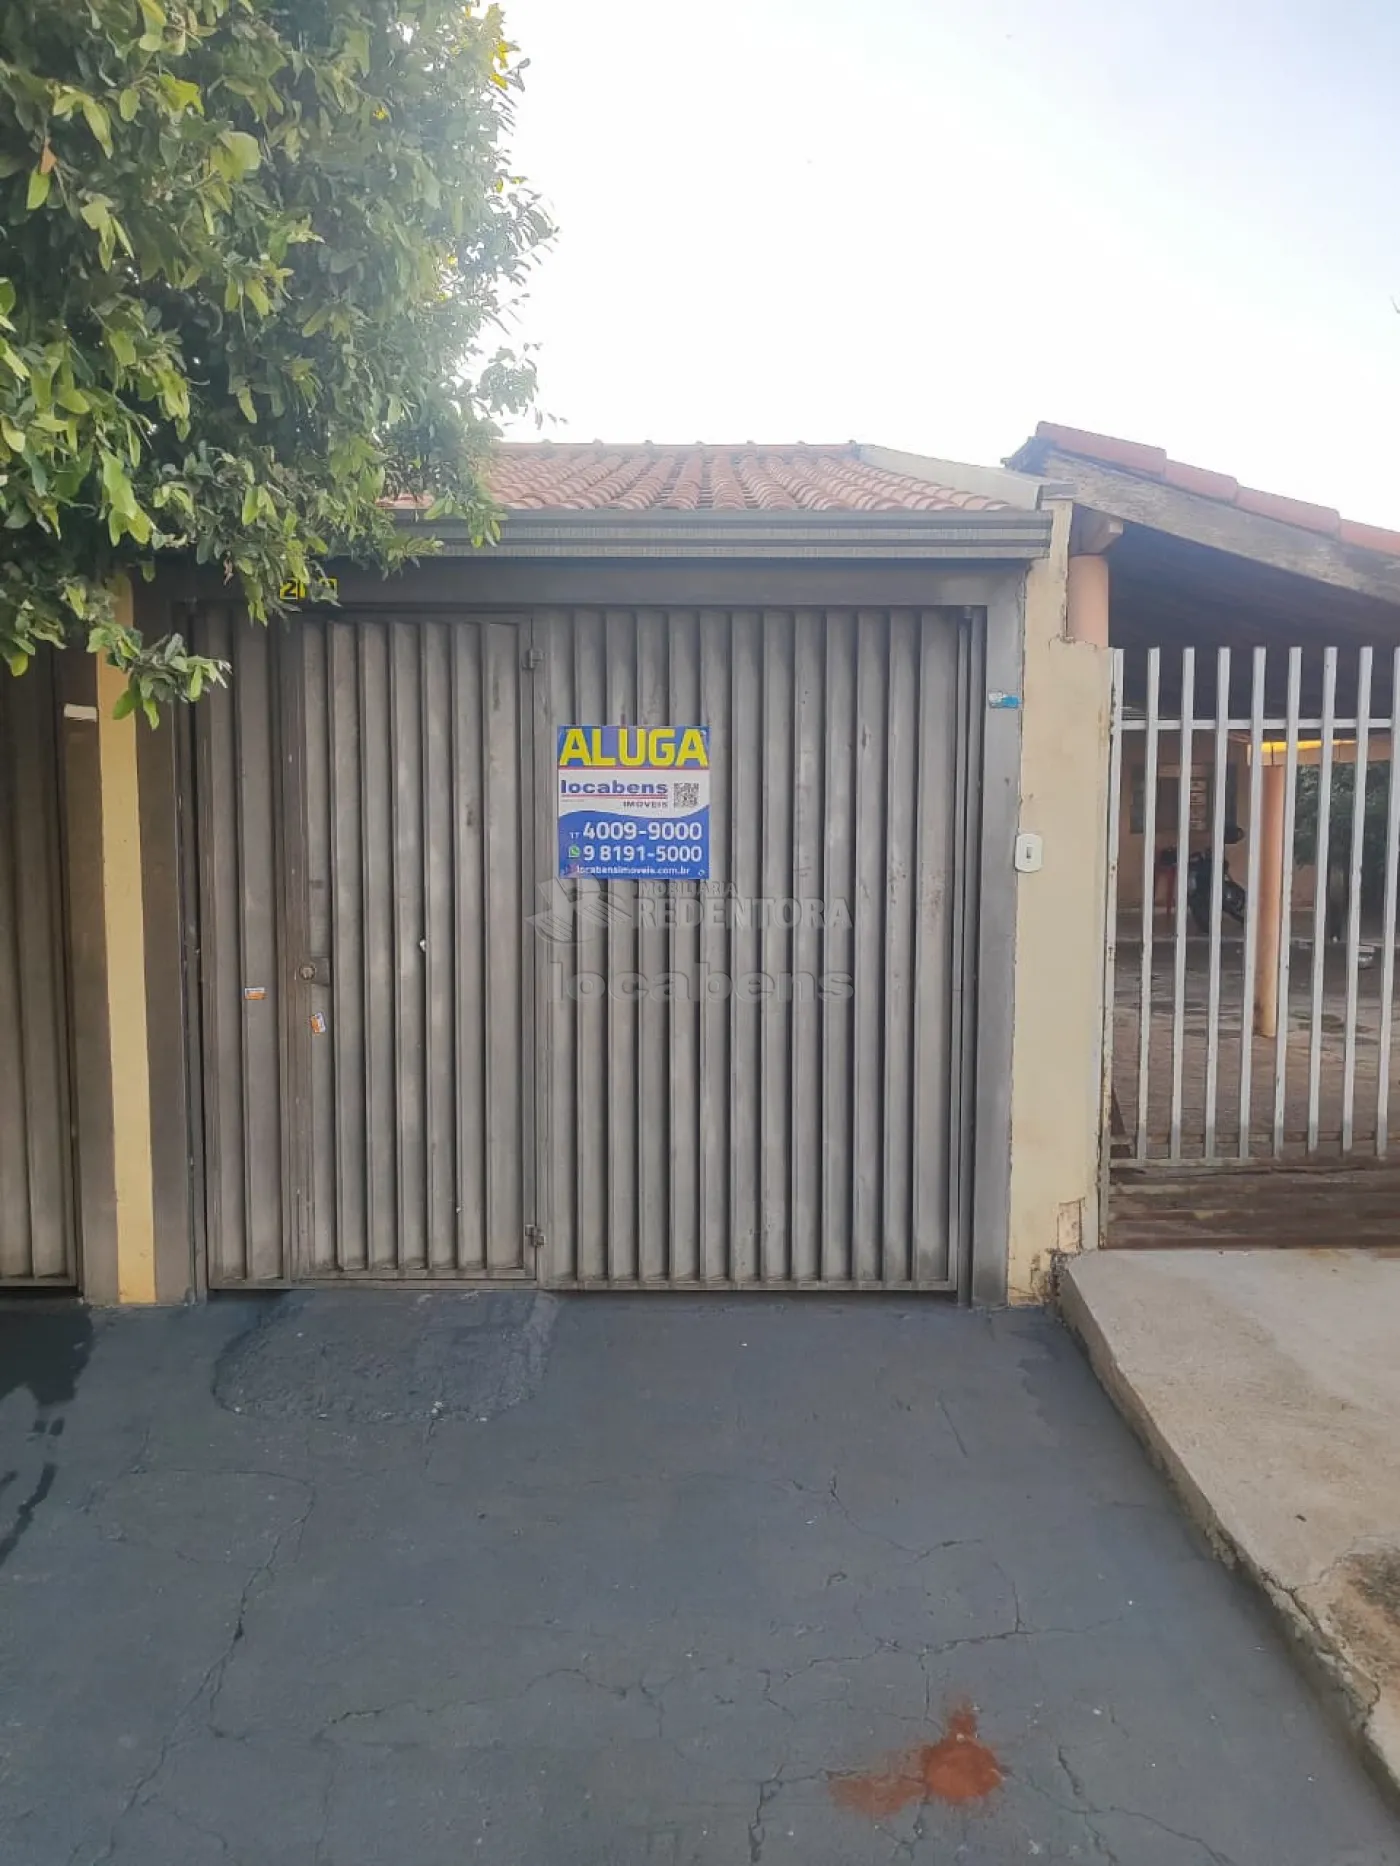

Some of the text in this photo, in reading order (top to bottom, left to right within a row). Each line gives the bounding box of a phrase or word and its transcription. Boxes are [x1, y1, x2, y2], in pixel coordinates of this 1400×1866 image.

[559, 728, 708, 766] ALUGA
[561, 780, 668, 794] locabens
[583, 822, 702, 840] 4009-9000
[583, 845, 702, 862] 9 8191-5000
